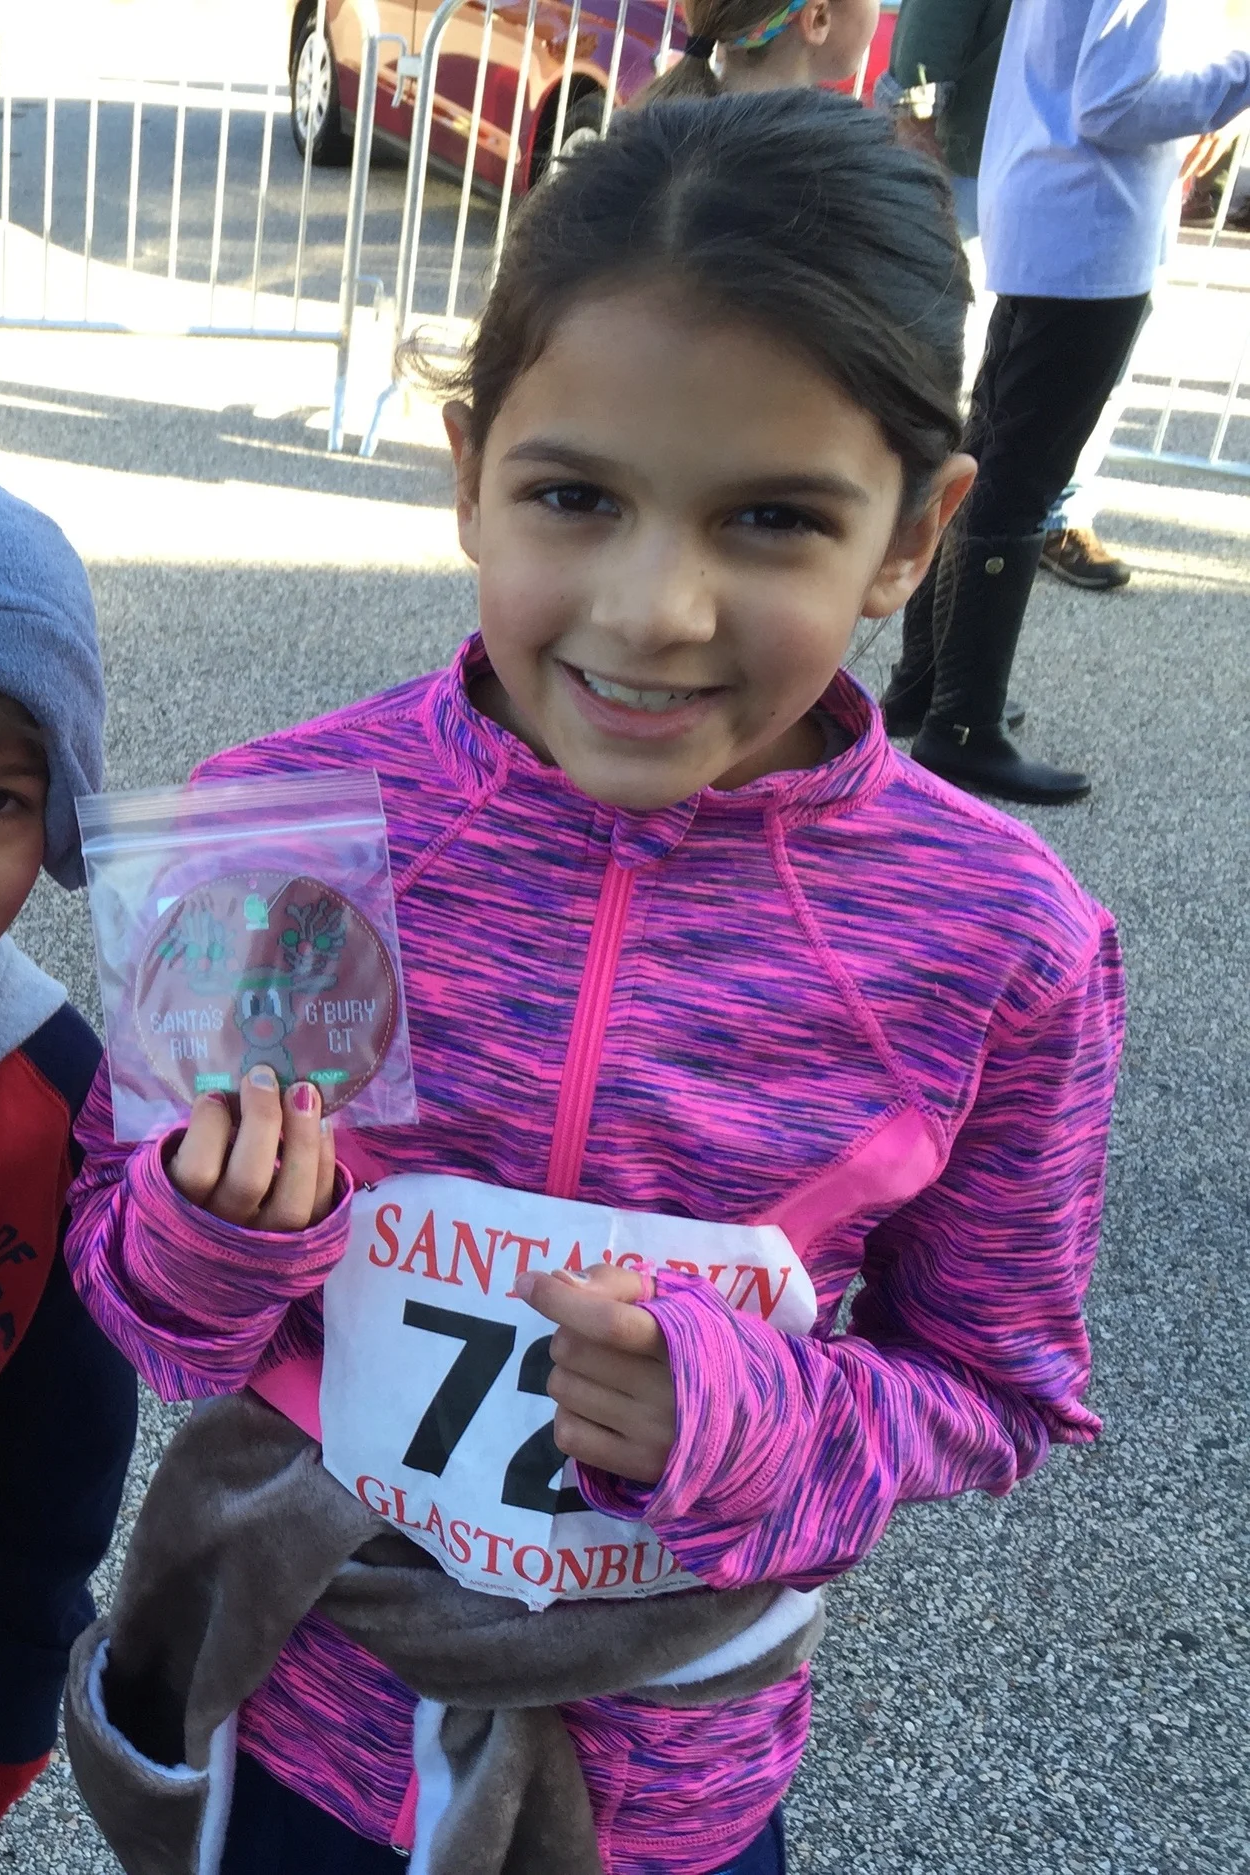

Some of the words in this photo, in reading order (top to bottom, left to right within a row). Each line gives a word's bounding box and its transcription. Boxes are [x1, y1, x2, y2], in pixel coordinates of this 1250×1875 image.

[150, 1004, 224, 1035] SANTA'S
[304, 999, 376, 1025] G'BURY
[170, 1037, 208, 1060] RUN
[328, 1028, 353, 1053] CT
[368, 1202, 643, 1299] SANT'
[665, 1259, 792, 1322] UN
[356, 1473, 683, 1594] GLASTONBU
